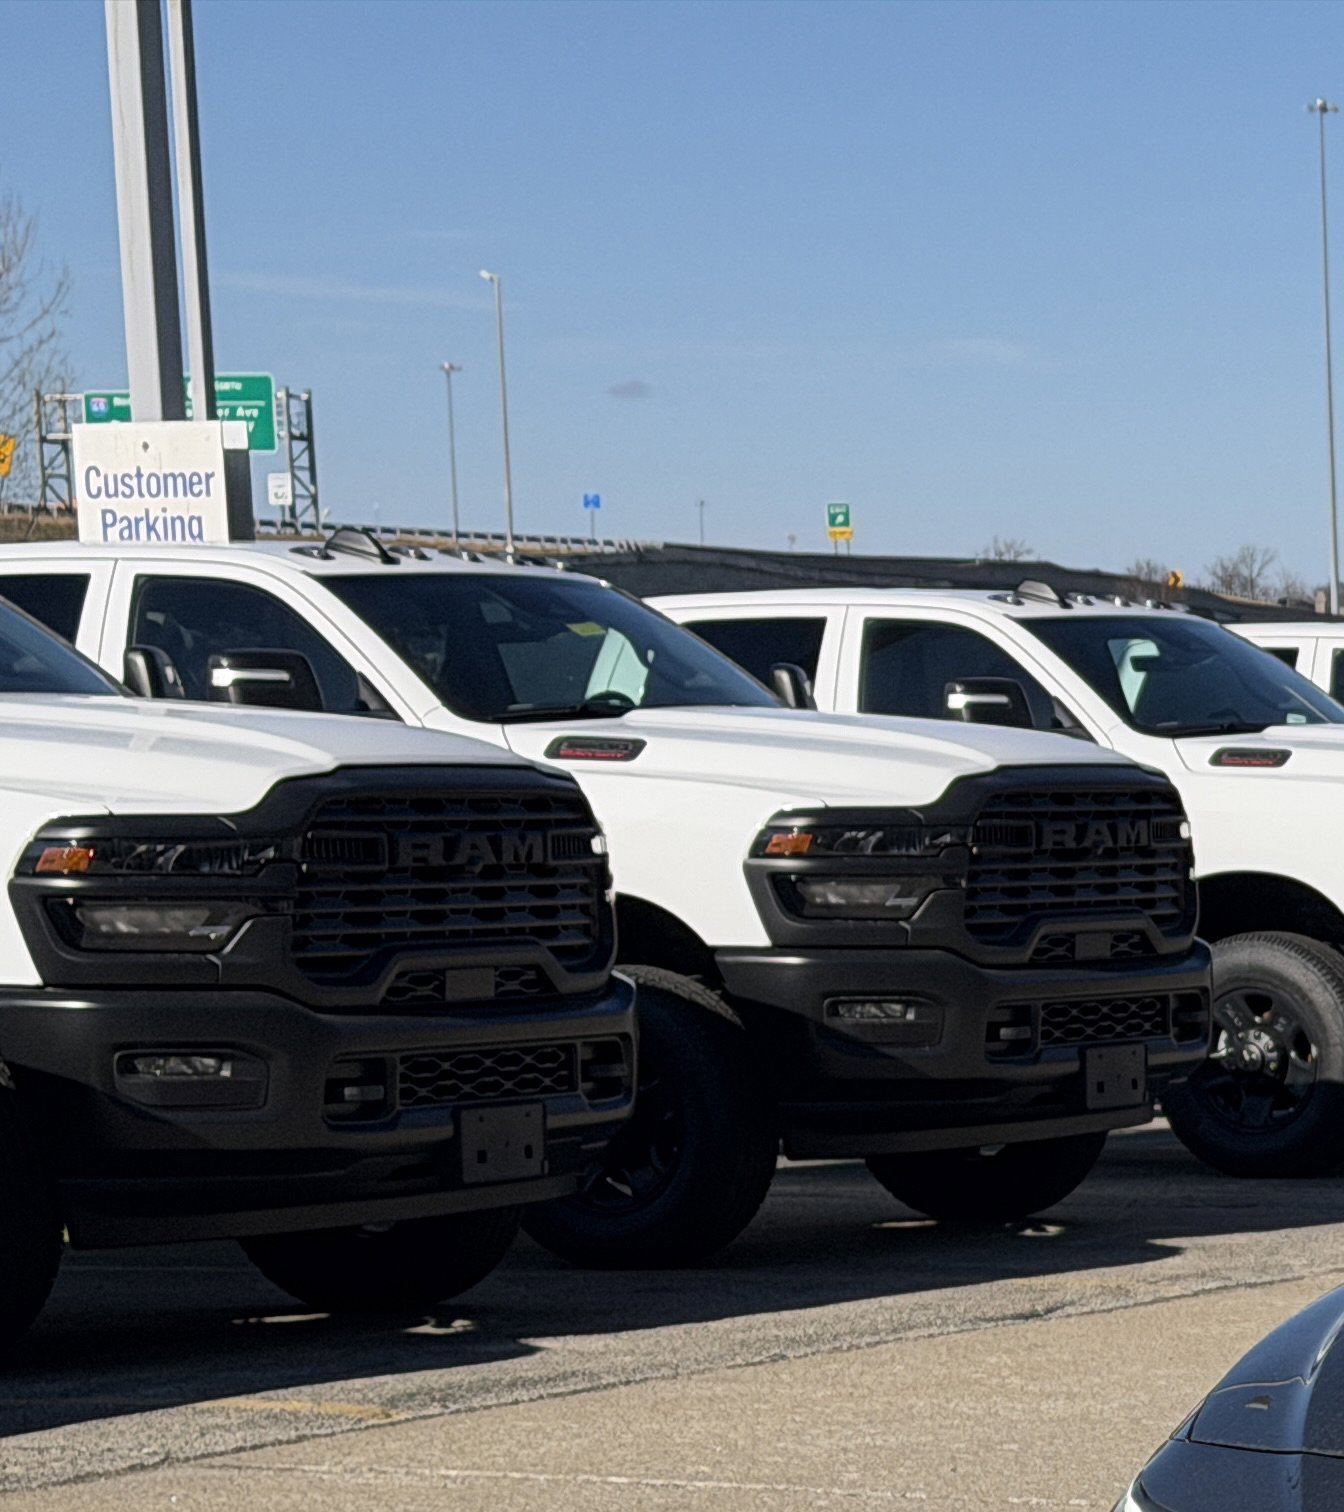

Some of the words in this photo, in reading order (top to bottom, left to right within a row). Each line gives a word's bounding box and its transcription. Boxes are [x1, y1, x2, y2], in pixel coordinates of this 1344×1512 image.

[84, 465, 216, 499] Customer
[399, 831, 544, 866] RAM
[1042, 819, 1148, 850] RAM
